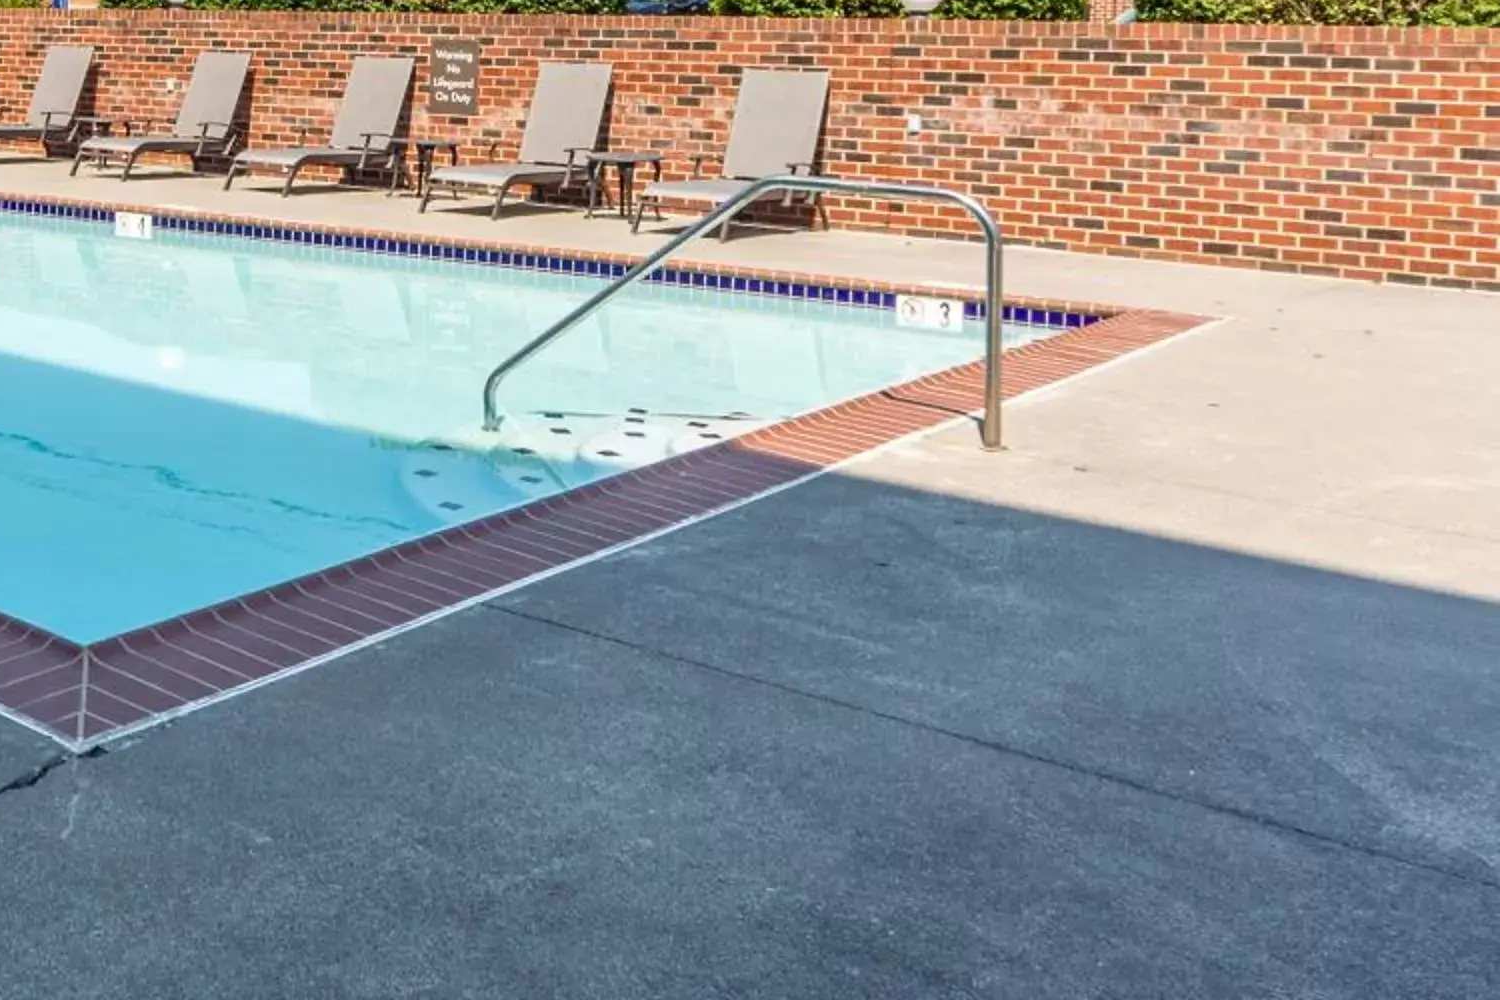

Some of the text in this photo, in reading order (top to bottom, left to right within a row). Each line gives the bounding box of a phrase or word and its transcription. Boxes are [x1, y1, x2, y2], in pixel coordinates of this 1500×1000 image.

[435, 49, 473, 64] Warning
[446, 63, 461, 74] No
[433, 75, 475, 91] Lifeguard
[435, 91, 472, 105] On Duty
[939, 301, 951, 329] 3
